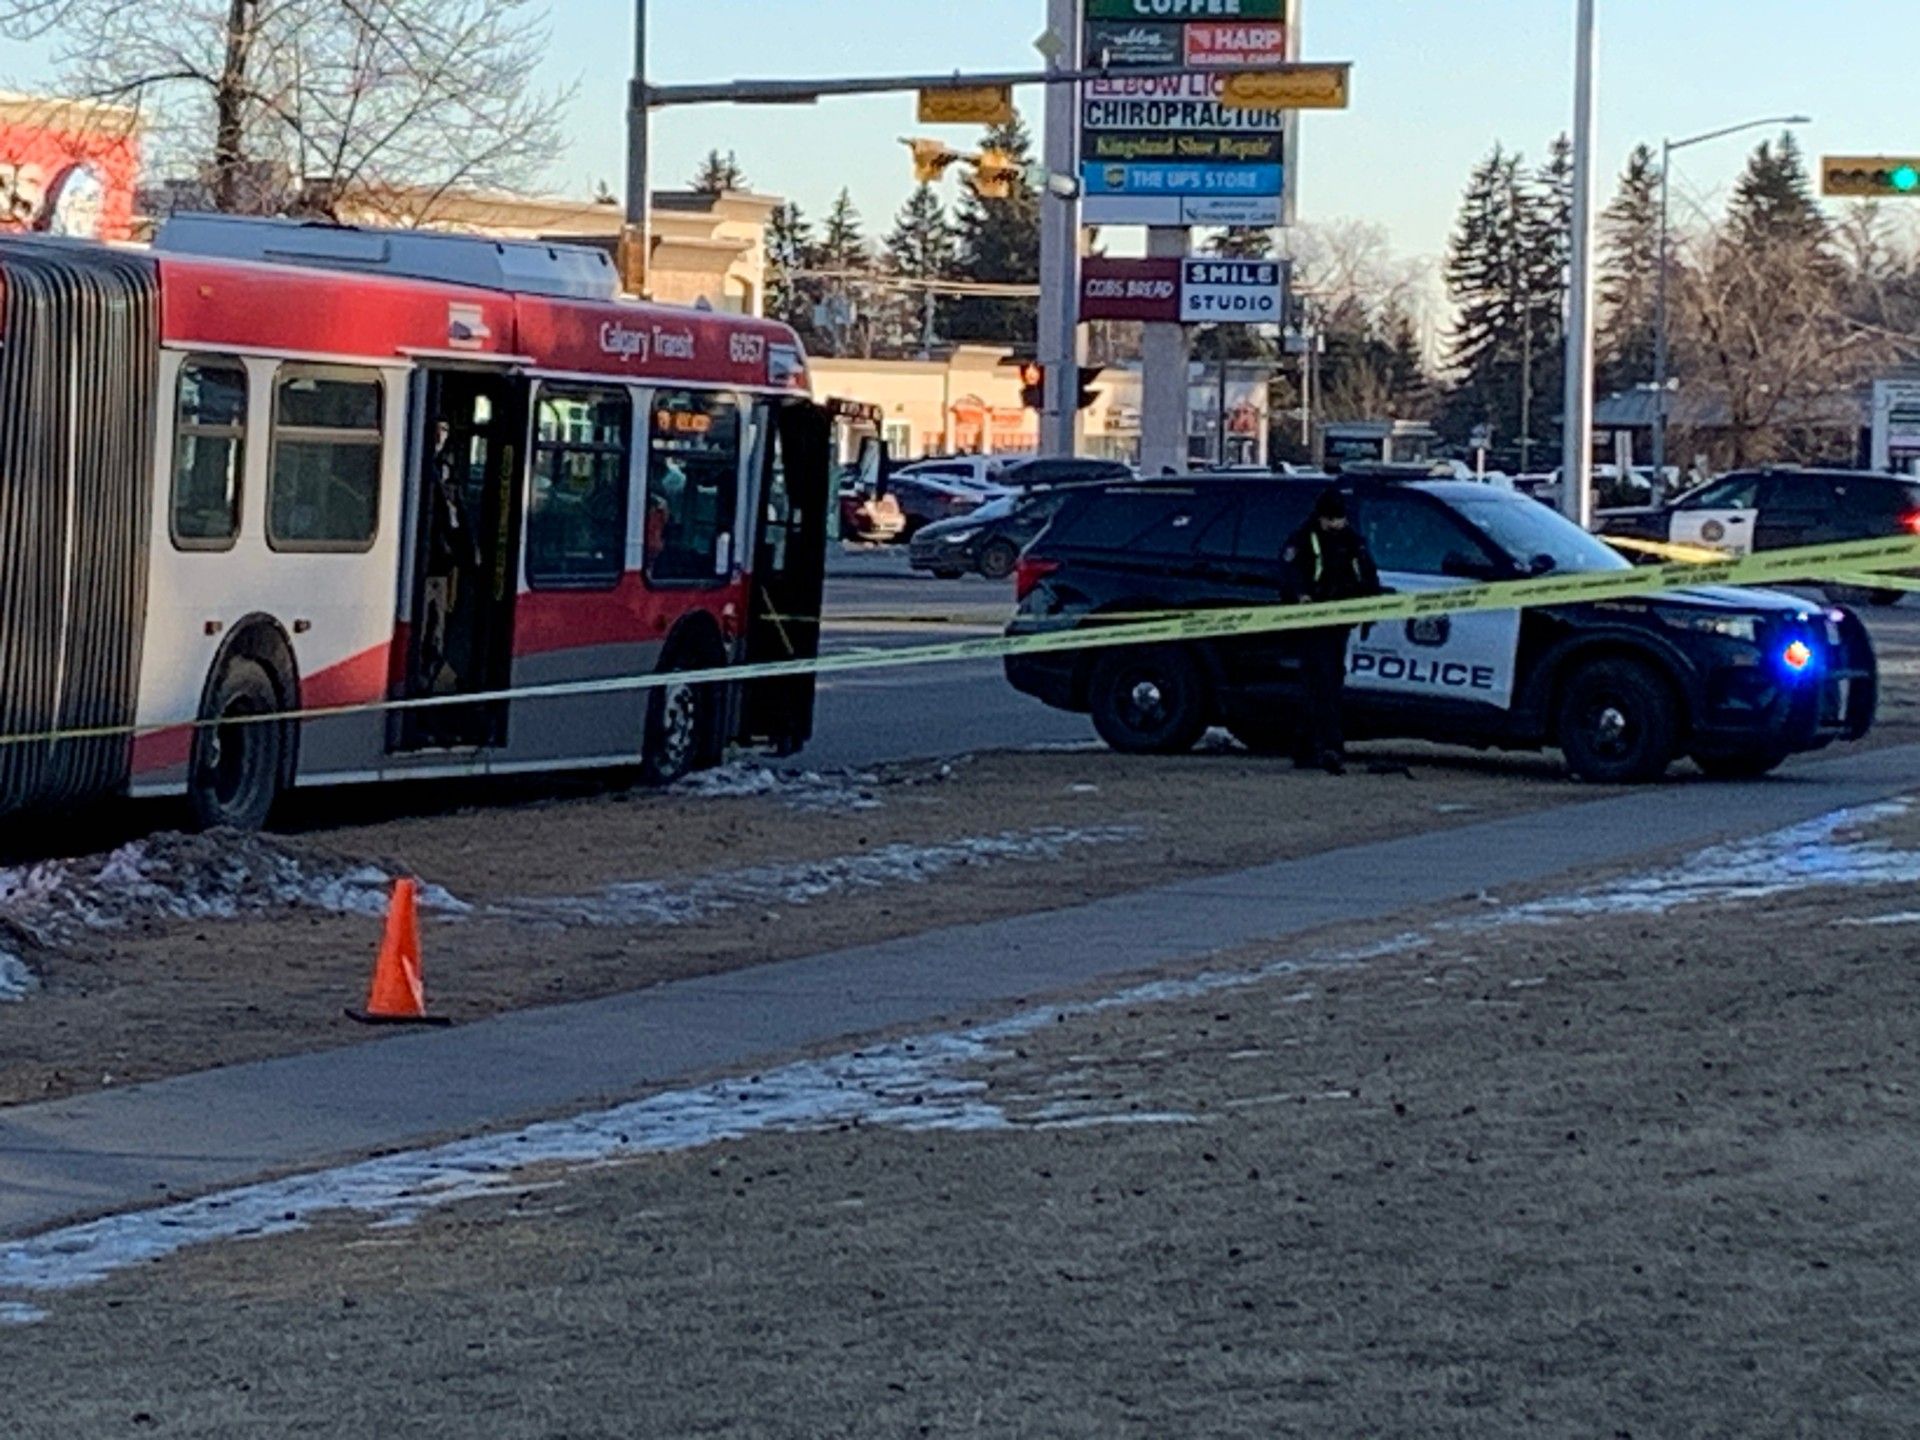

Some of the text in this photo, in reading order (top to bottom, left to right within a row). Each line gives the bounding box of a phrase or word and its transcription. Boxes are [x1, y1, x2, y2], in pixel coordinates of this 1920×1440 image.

[1133, 0, 1241, 14] COFFEE
[1215, 28, 1282, 49] HARP
[1093, 75, 1181, 96] ELBOW
[1087, 101, 1281, 126] CHIROPRACTOR
[1133, 170, 1162, 188] THE
[1167, 171, 1200, 188] UPS
[1205, 171, 1257, 188] STORE
[1192, 264, 1272, 283] SMILE
[1126, 280, 1174, 298] BREAD
[1190, 295, 1272, 311] STUDIO
[600, 321, 694, 362] Calgary Transit
[1351, 653, 1495, 689] POLICE
